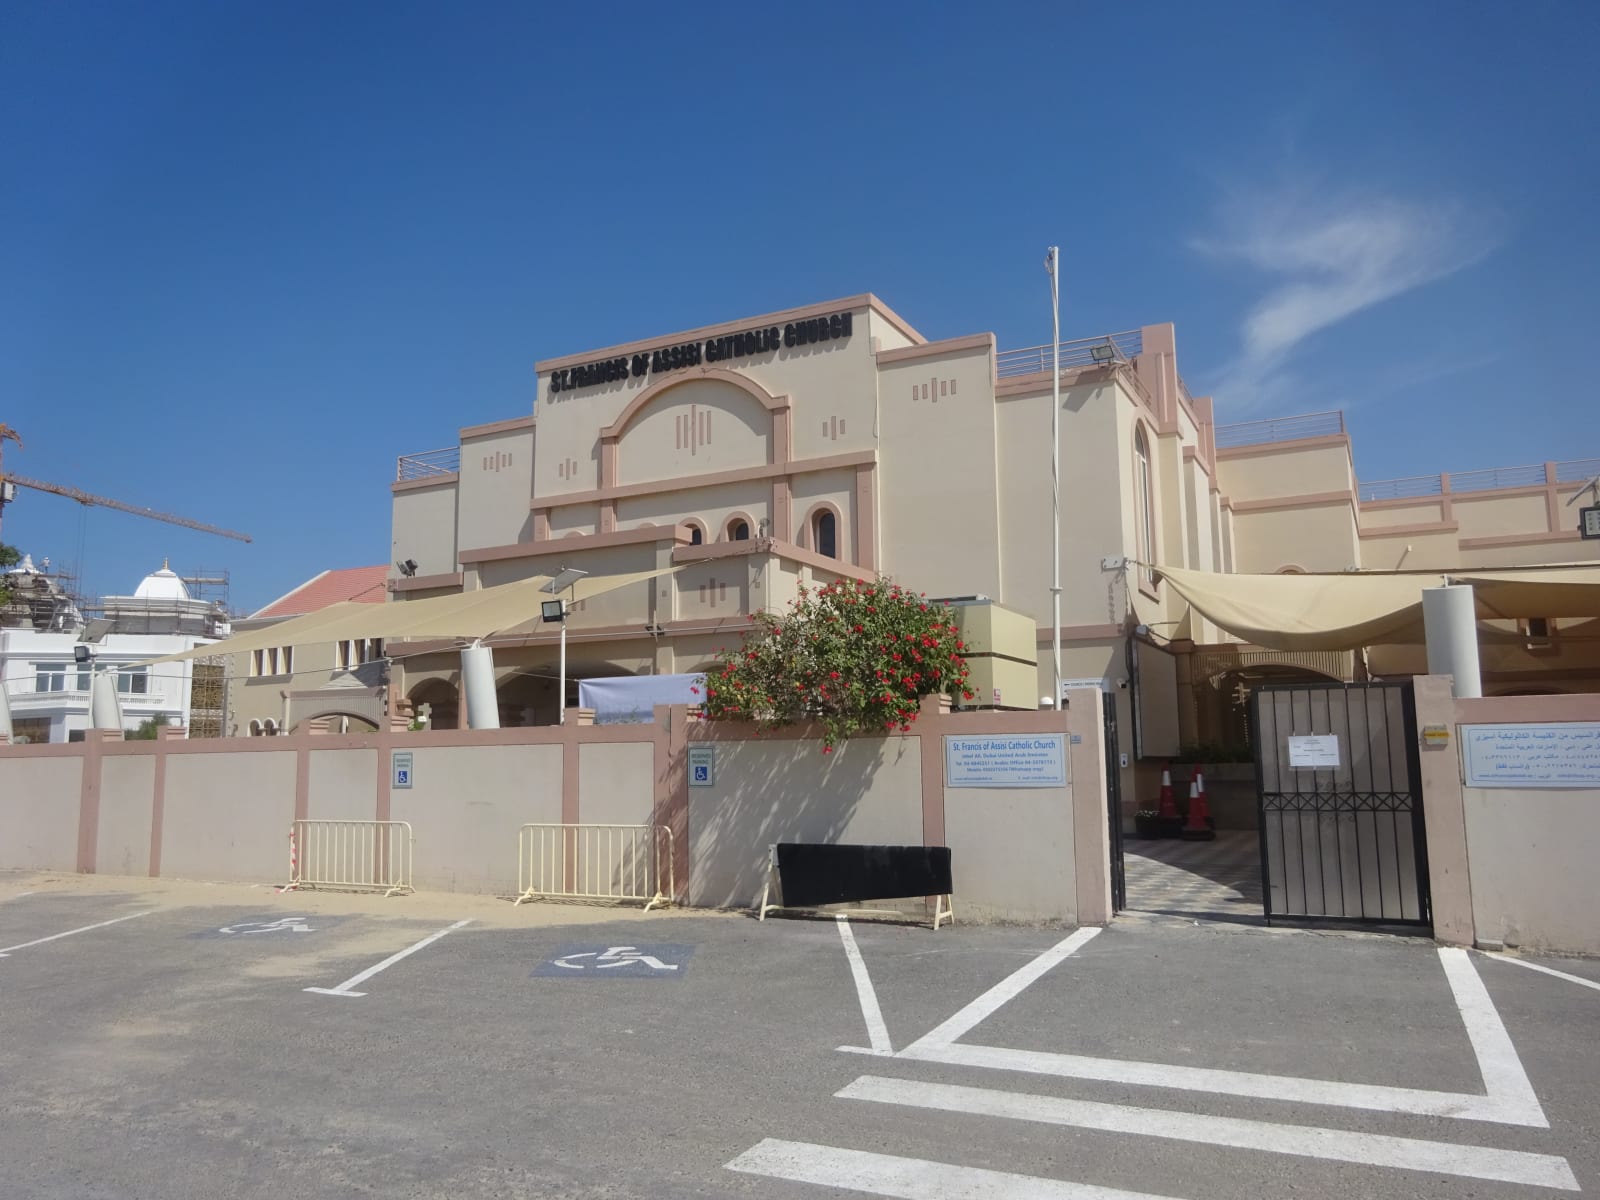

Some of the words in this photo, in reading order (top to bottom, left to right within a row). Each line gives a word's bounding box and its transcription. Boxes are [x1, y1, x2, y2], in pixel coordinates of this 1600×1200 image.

[632, 352, 649, 377] OF
[652, 342, 702, 373] ASSISI
[706, 326, 780, 362] CATHOLIC
[784, 312, 852, 347] CHURCH
[962, 742, 982, 750] Francis
[983, 742, 989, 750] of
[991, 741, 1007, 750] Assisi
[1008, 741, 1033, 750] Catholic
[1034, 740, 1056, 749] Church
